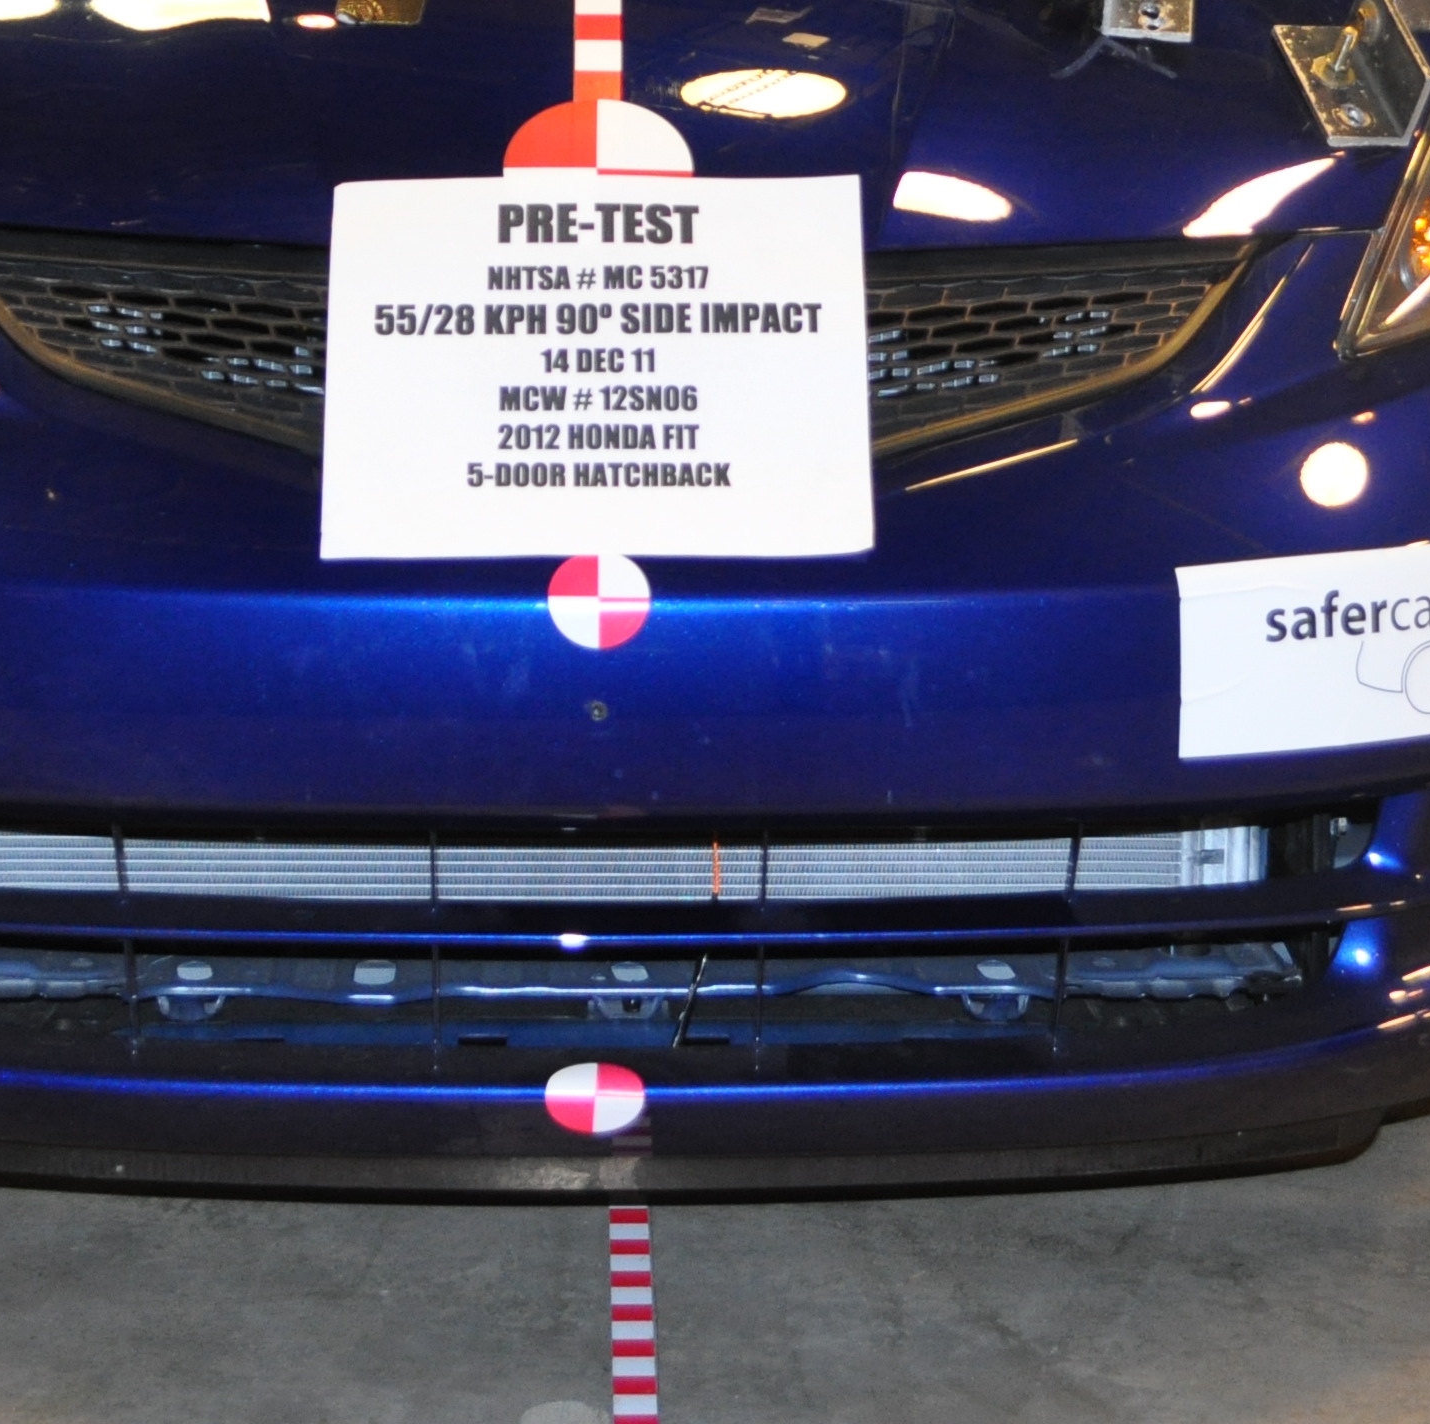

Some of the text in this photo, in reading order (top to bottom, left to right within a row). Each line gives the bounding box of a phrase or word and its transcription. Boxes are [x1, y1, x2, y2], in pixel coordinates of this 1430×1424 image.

[498, 203, 700, 245] PRE-TEST
[488, 265, 709, 291] NHTSA # MC 5317
[375, 302, 475, 336] 55/28
[484, 302, 547, 336] KPH
[620, 302, 692, 336] SIDE
[700, 302, 822, 336] IMPACT
[541, 347, 655, 374] 14 DEC 11
[499, 385, 698, 412] MCW # 12SN06
[498, 423, 700, 450] 2012 HONDA FIT
[467, 462, 731, 488] 5-DOOR HATCHBACK
